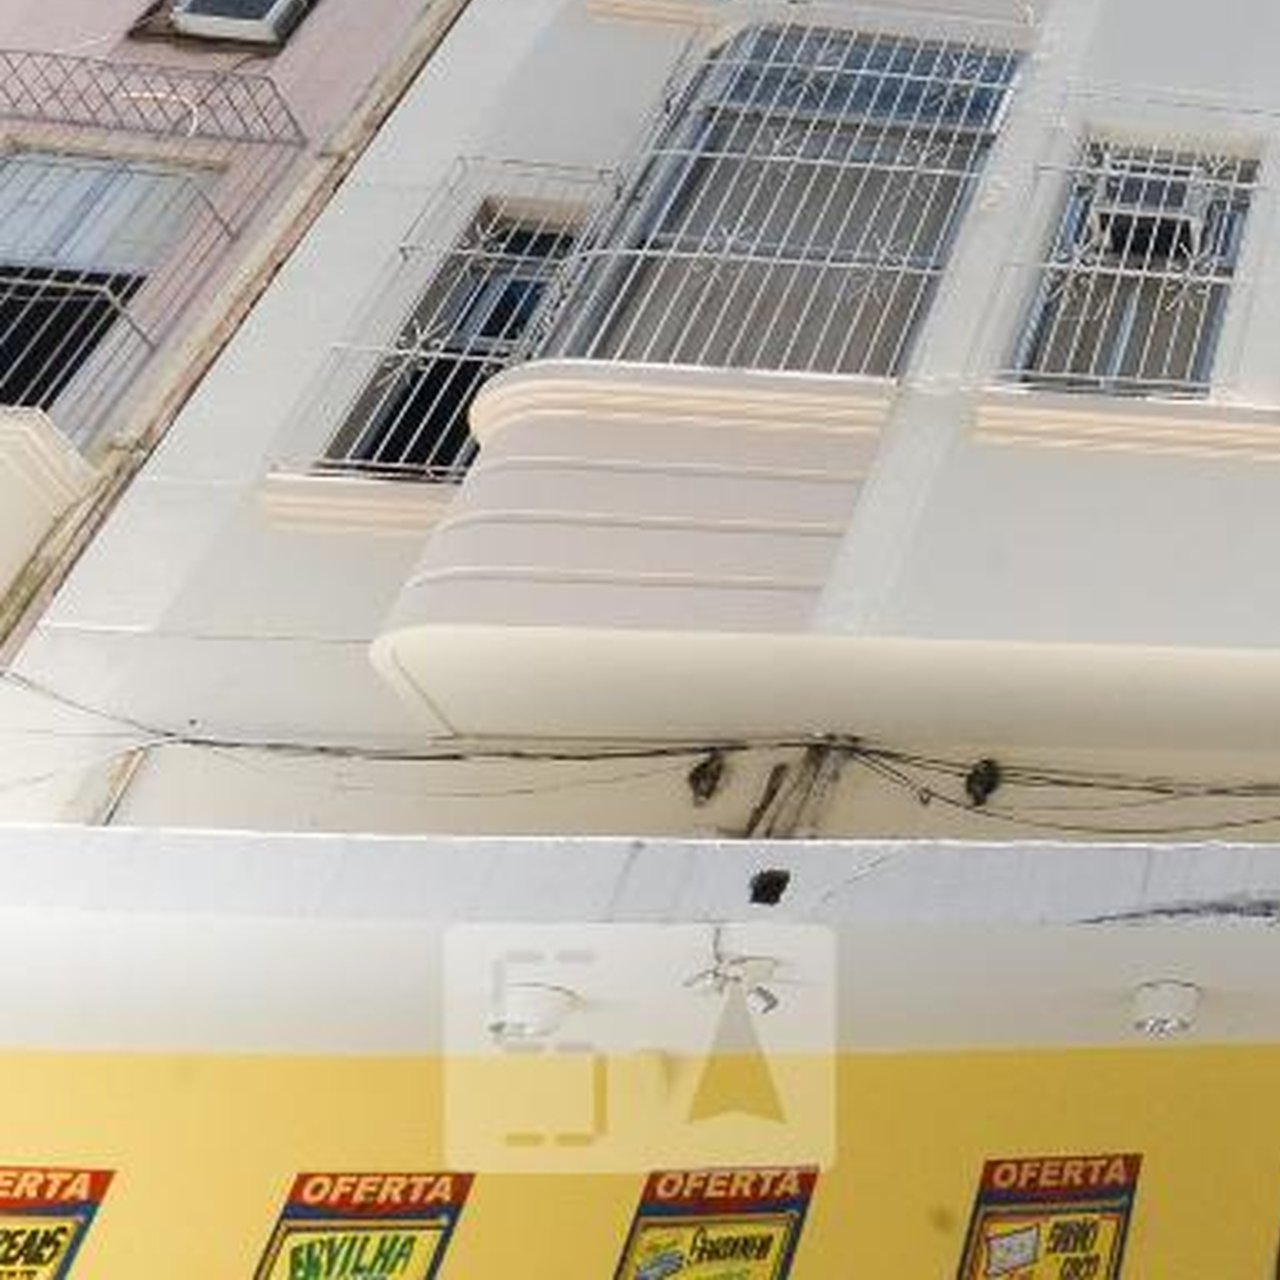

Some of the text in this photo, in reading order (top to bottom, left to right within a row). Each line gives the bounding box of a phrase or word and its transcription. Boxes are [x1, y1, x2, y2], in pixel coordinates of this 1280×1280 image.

[655, 1169, 800, 1199] OFERTA
[991, 1157, 1127, 1190] OFERTA
[301, 1175, 453, 1204] OFERTA
